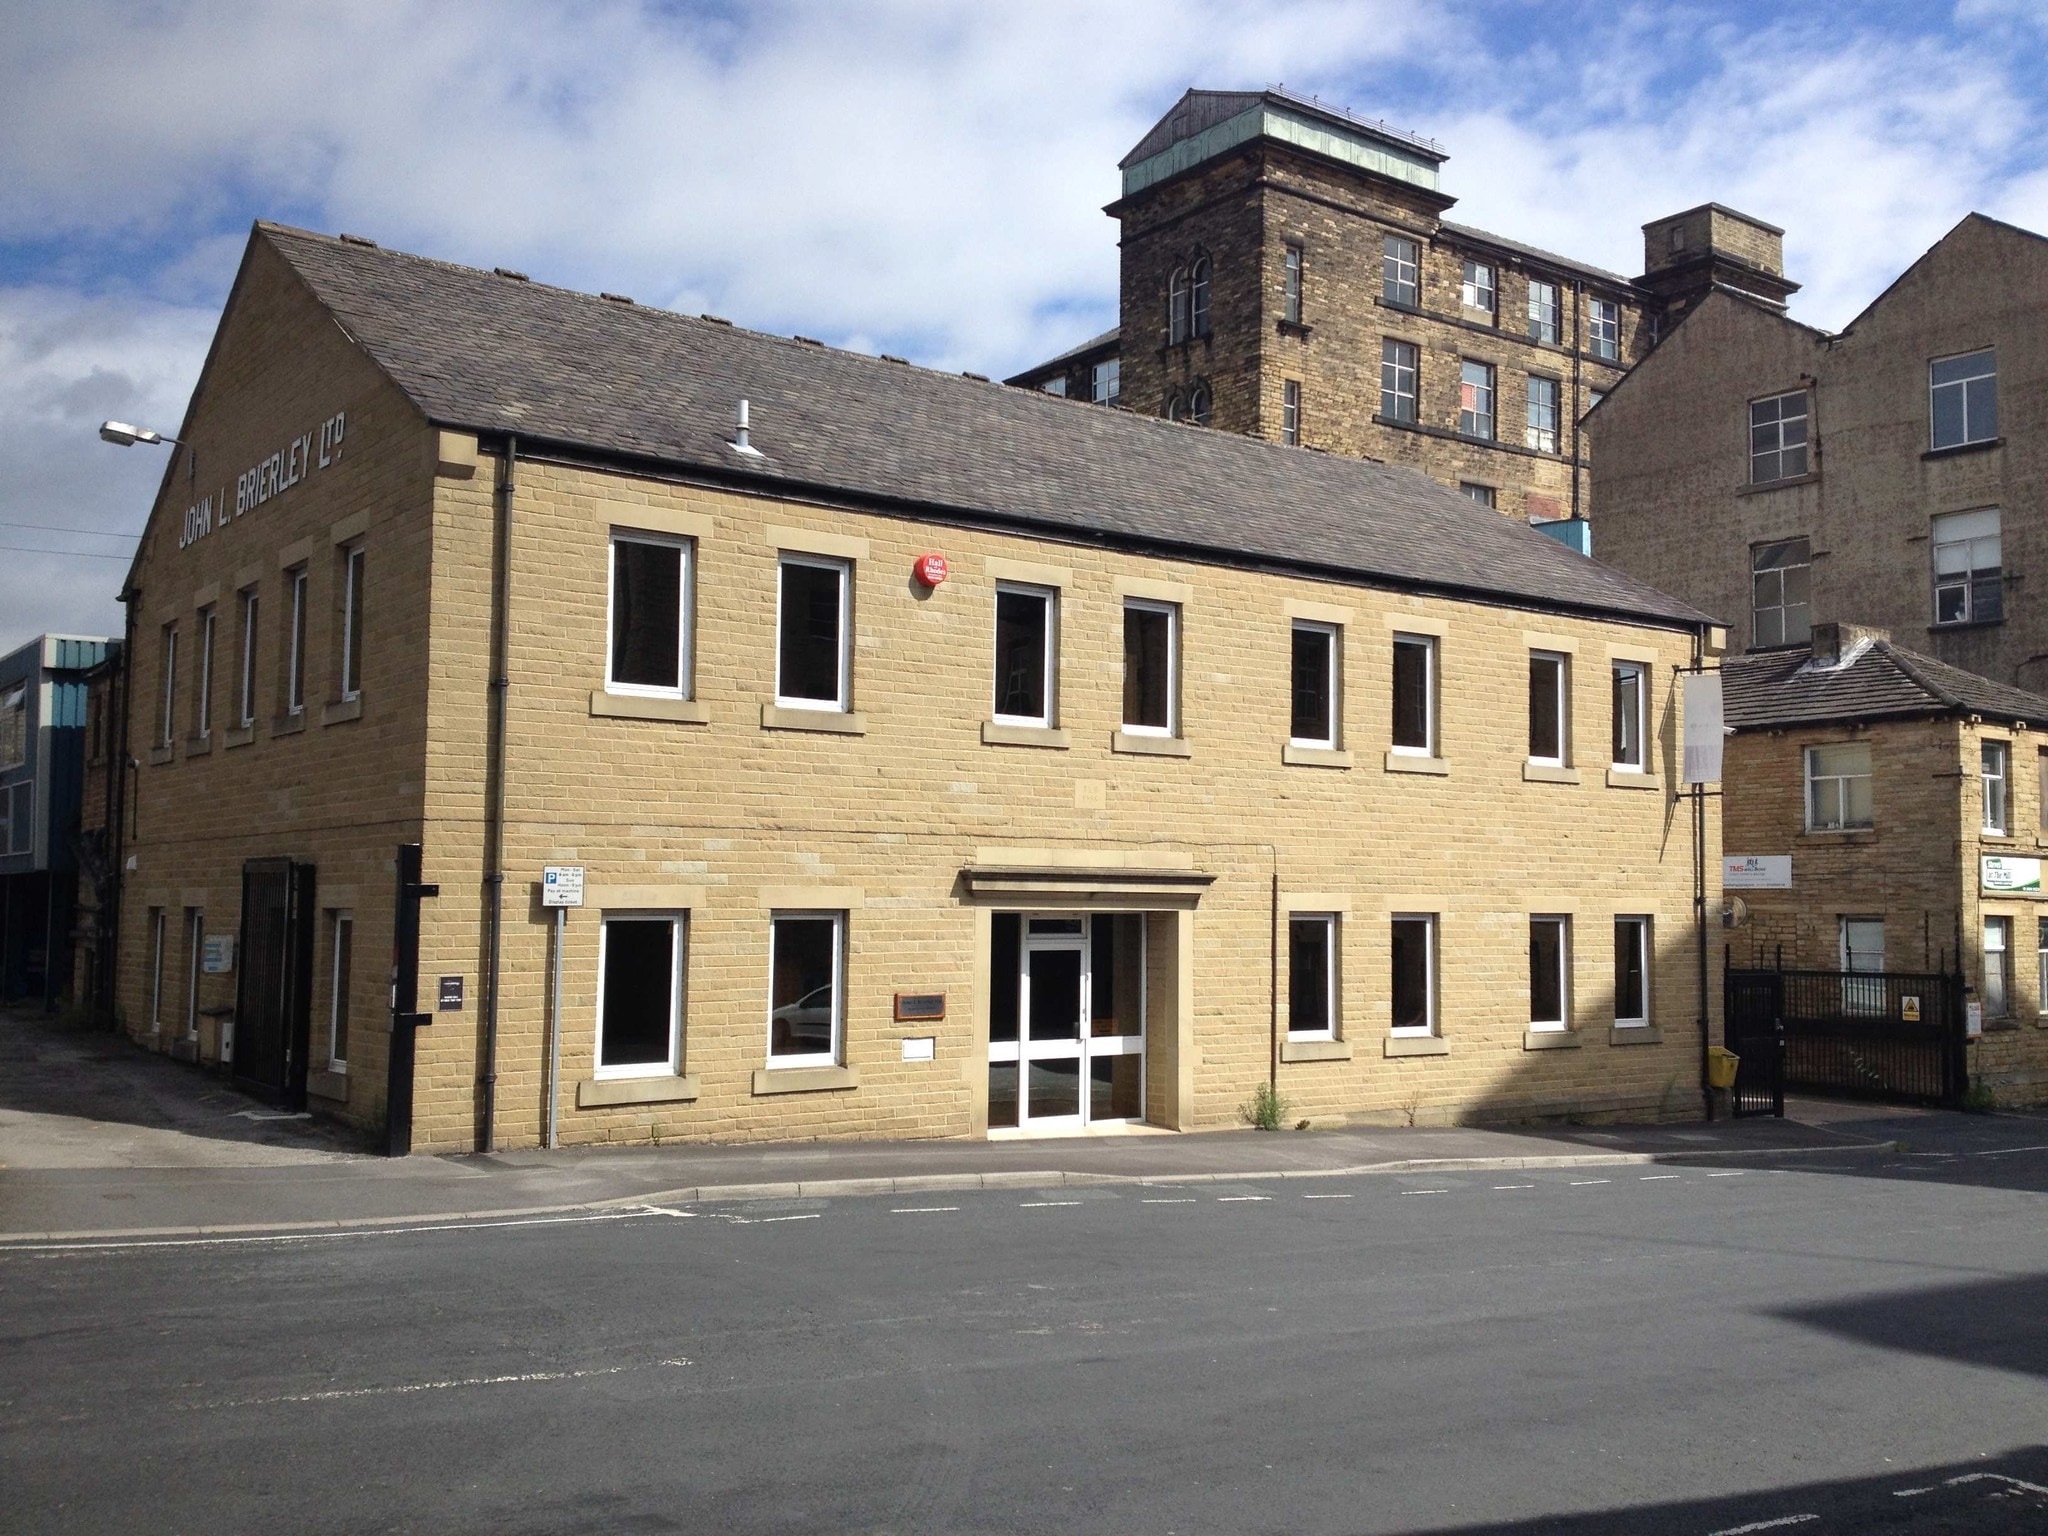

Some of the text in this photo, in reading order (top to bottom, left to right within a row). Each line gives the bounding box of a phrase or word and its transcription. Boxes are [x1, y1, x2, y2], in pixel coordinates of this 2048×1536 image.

[179, 494, 213, 549] JOHN
[235, 430, 313, 517] BRIERLEY
[928, 557, 943, 566] Hall
[925, 566, 946, 575] Rhodes
[548, 873, 556, 883] P
